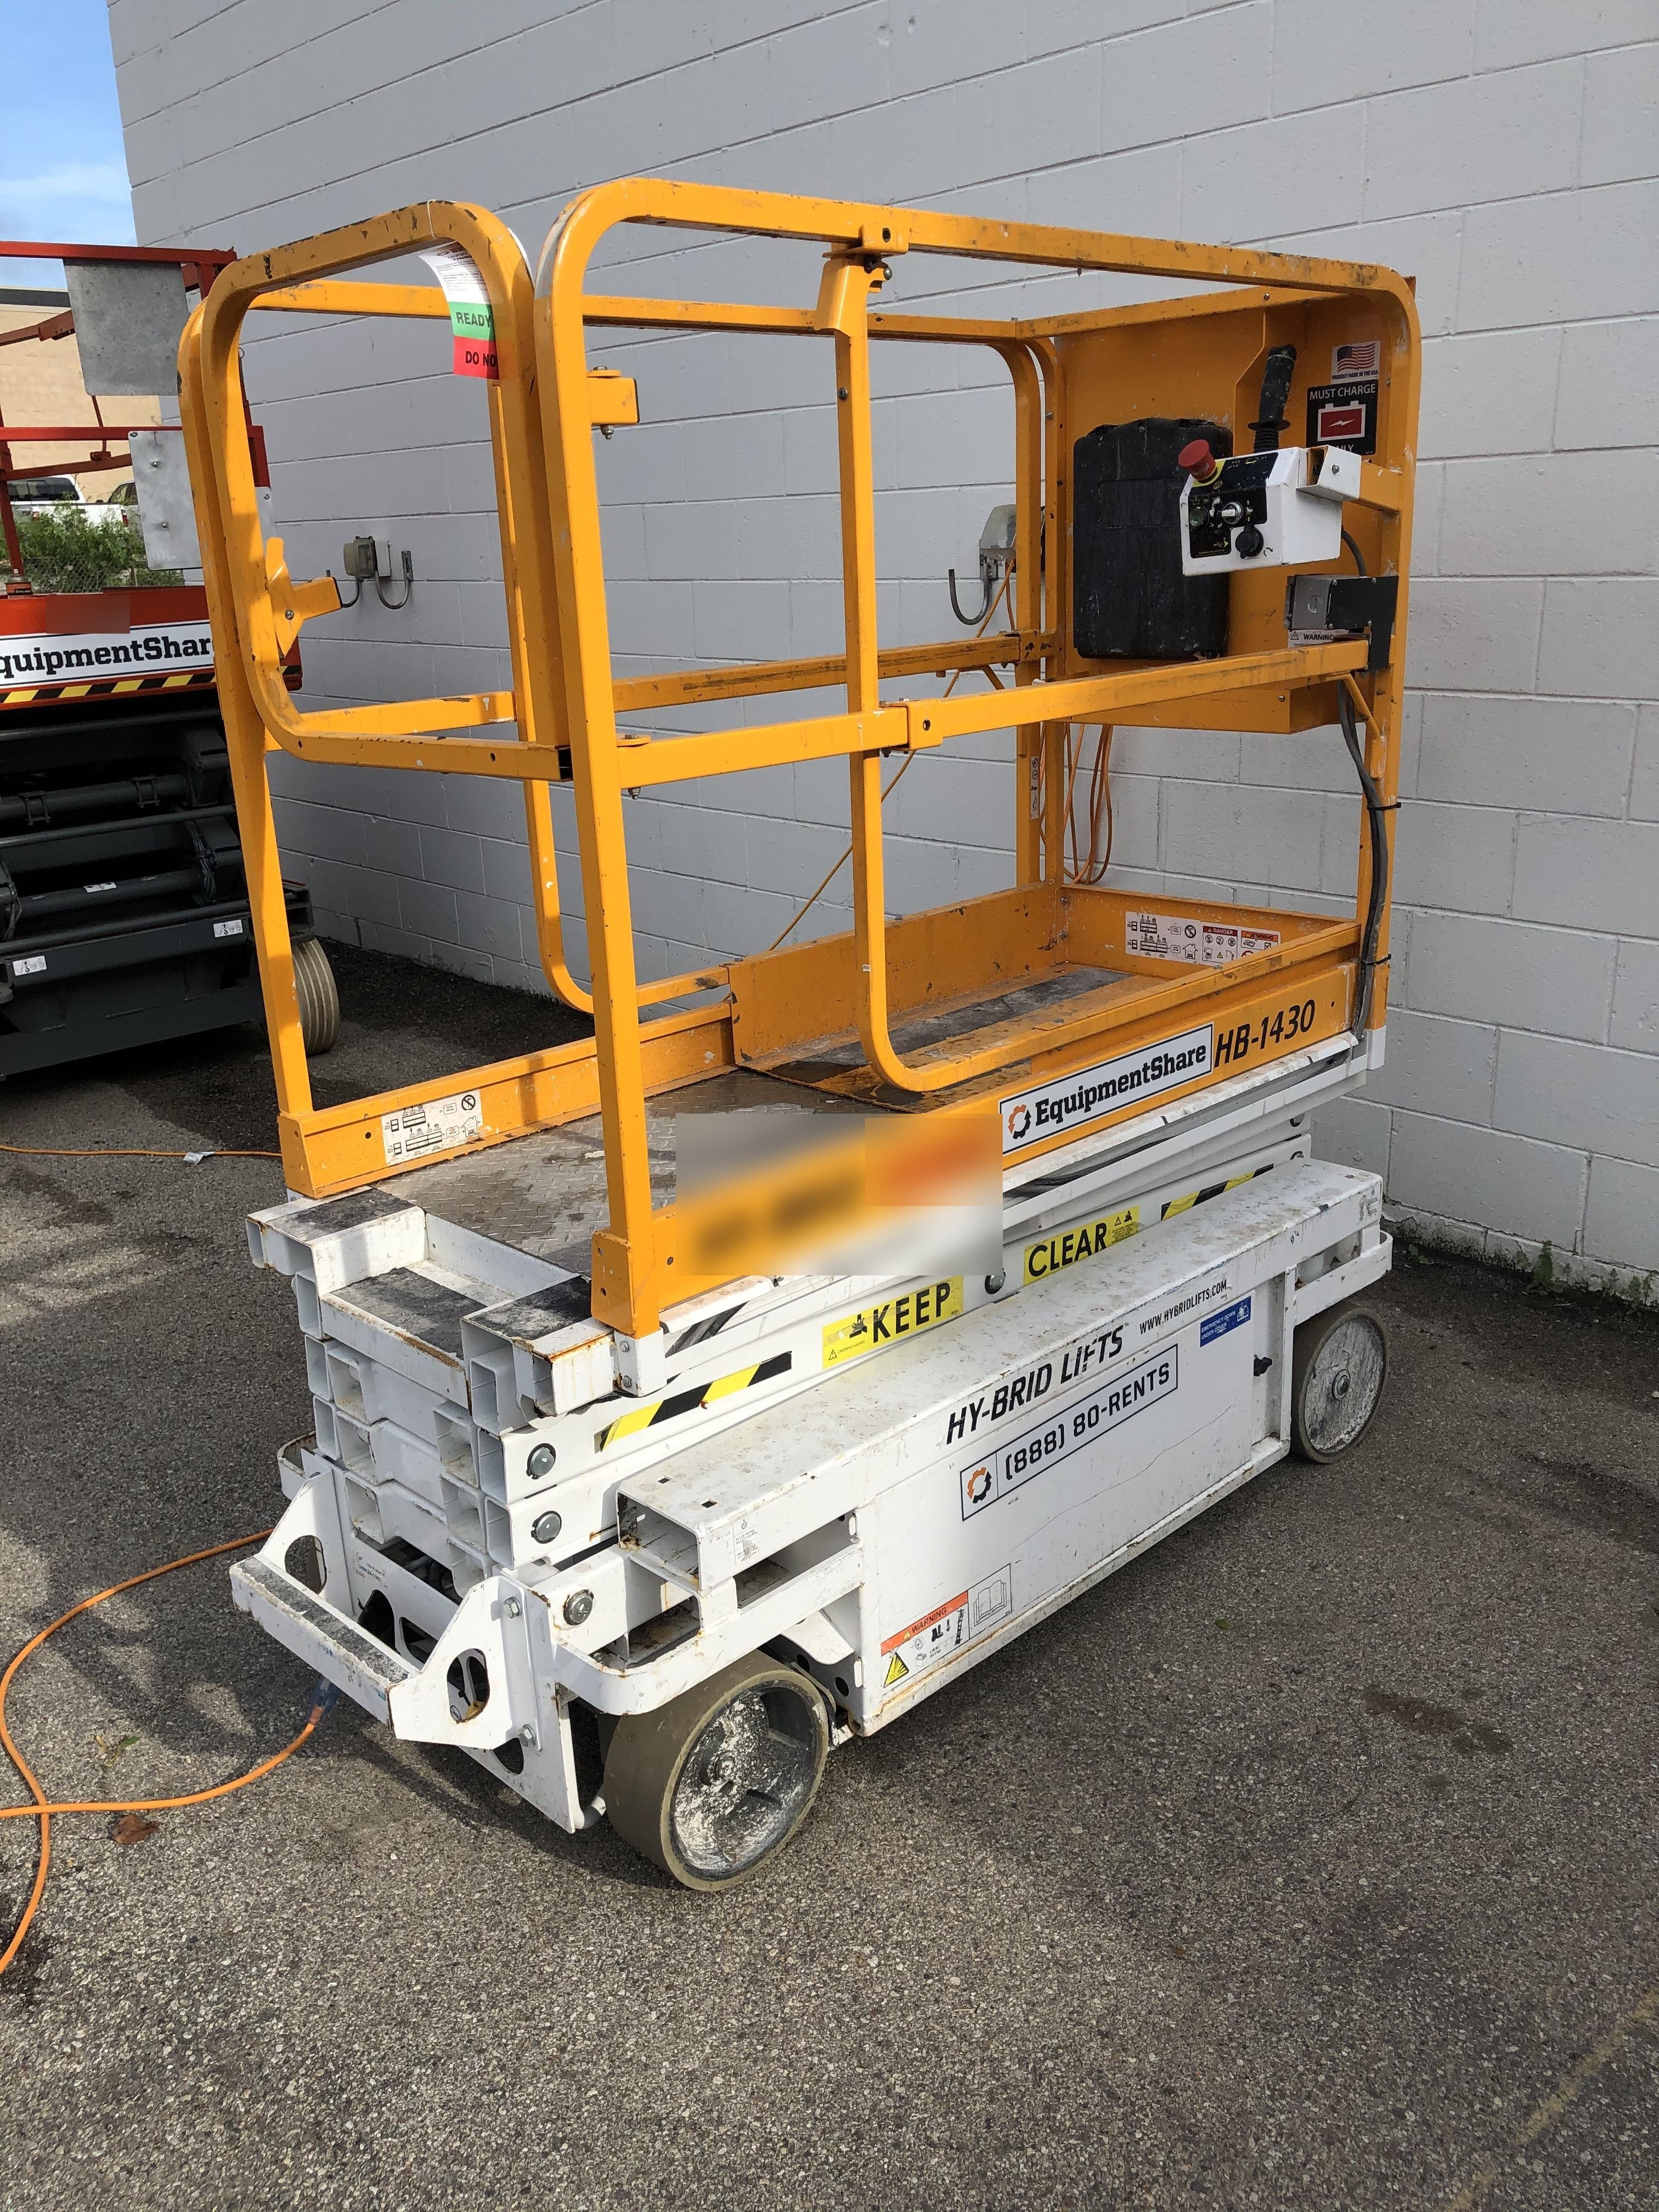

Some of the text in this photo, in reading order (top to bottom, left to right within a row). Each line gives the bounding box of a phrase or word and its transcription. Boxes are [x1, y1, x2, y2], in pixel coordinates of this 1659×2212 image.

[456, 312, 492, 328] READY
[465, 351, 498, 367] DO NO
[1310, 383, 1376, 400] MUST CHARGE
[0, 636, 211, 679] quipmentShar
[1214, 998, 1316, 1068] HB-1430
[1035, 1044, 1206, 1127] EquipmentShare
[1028, 1222, 1107, 1277] CLEAR
[873, 1282, 951, 1344] KEEP
[1139, 1279, 1227, 1335] WWW.HYBRIDLIFTS.COM
[1201, 1310, 1236, 1333] EMERGENCY DOWN
[1201, 1322, 1227, 1340] UNDER COVER
[946, 1362, 1052, 1444] HY-BRID
[1060, 1324, 1124, 1385] LIFTS
[1005, 1362, 1170, 1481] (888) 80-RENTS
[911, 1607, 947, 1634] WARNING
